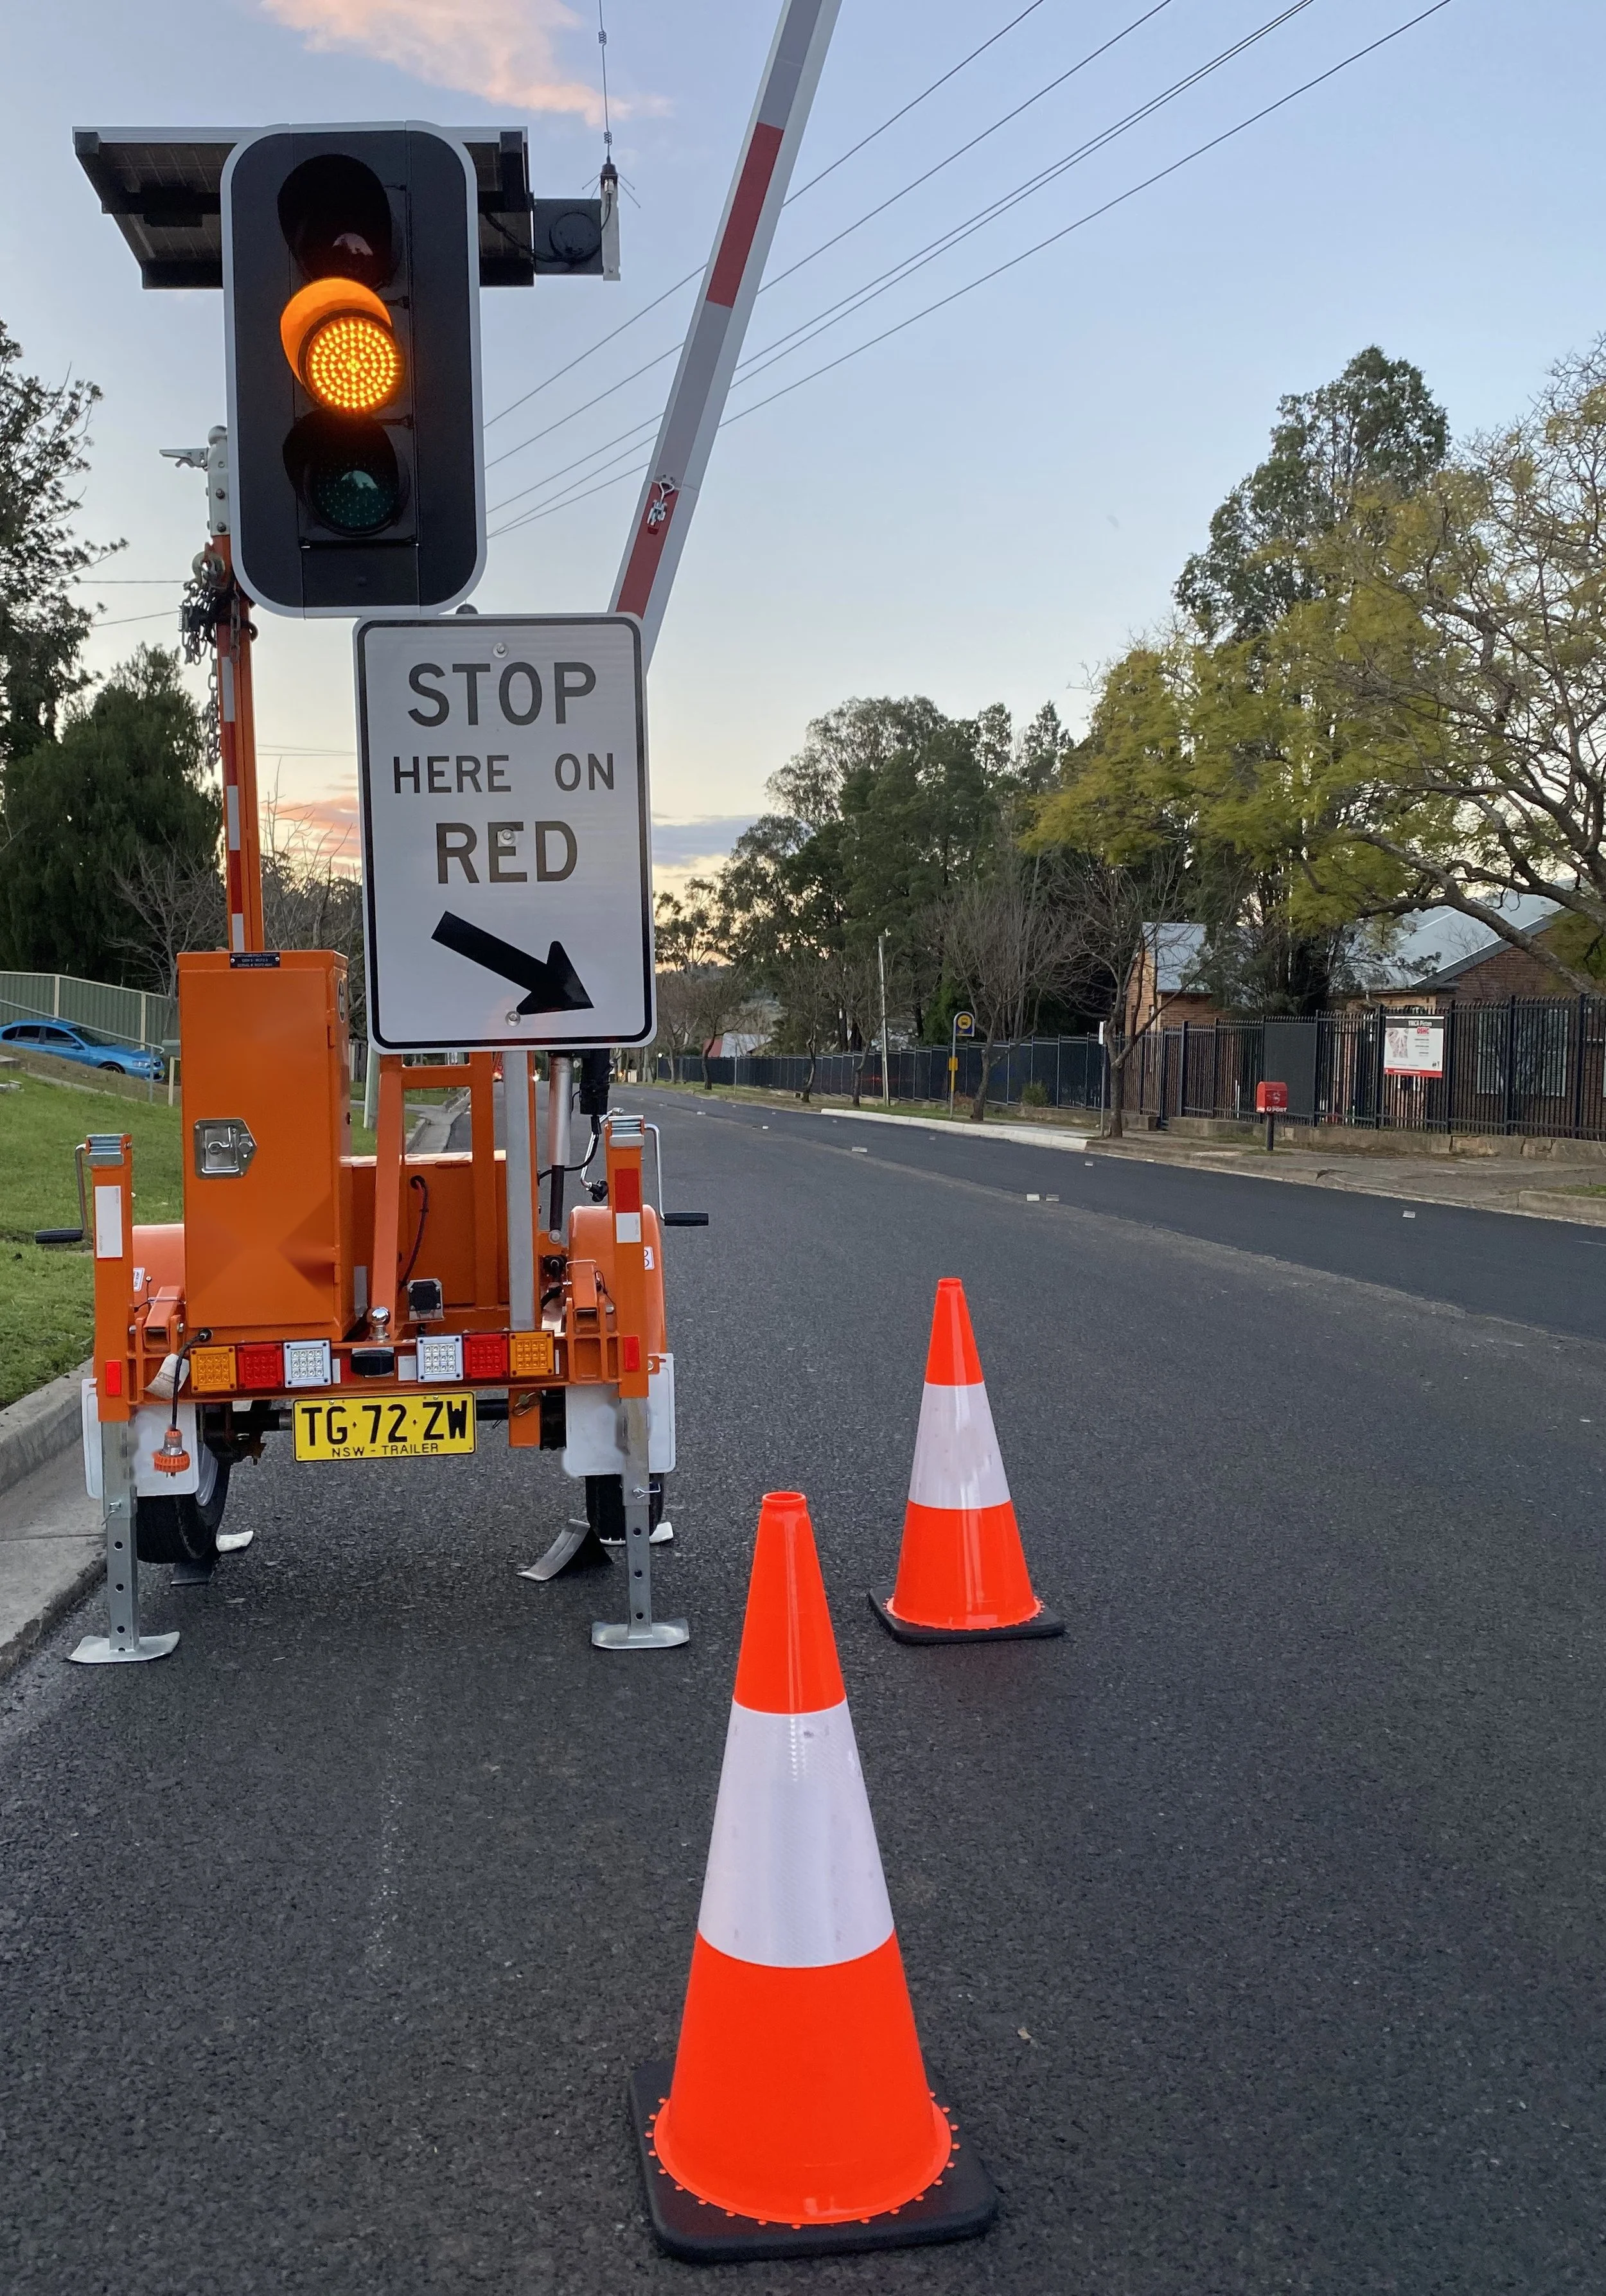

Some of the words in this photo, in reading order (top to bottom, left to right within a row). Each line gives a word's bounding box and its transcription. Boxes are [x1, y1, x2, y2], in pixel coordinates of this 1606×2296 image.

[407, 662, 596, 727] STOP
[393, 754, 512, 794] HERE
[554, 752, 615, 792] ON
[436, 820, 578, 885] RED
[331, 1447, 365, 1458] NSW
[382, 1443, 439, 1455] TRAILER
